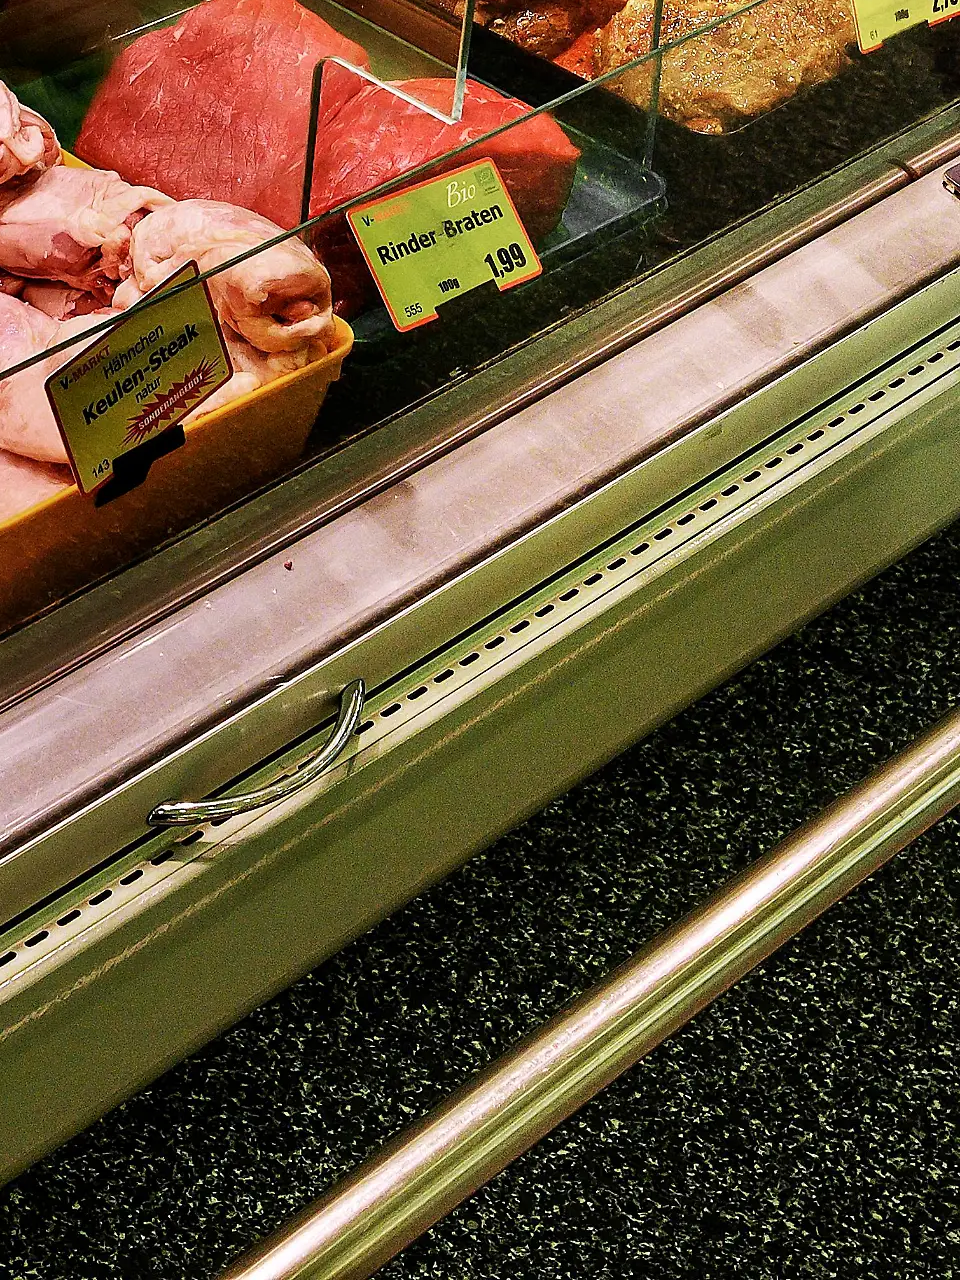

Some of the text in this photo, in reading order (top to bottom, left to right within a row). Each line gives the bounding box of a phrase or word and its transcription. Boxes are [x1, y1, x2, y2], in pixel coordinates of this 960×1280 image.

[446, 181, 476, 208] Bio
[376, 204, 504, 265] Rinder-Braten
[484, 242, 527, 279] 1,99
[437, 277, 460, 293] 100g
[404, 302, 423, 318] 555
[59, 344, 111, 390] V-MARKT
[102, 324, 164, 380] Hähnchen
[82, 322, 199, 426] Keulen-Steak
[134, 376, 162, 404] natur
[138, 372, 204, 430] SONDERANGEBOT
[92, 458, 111, 478] 143
